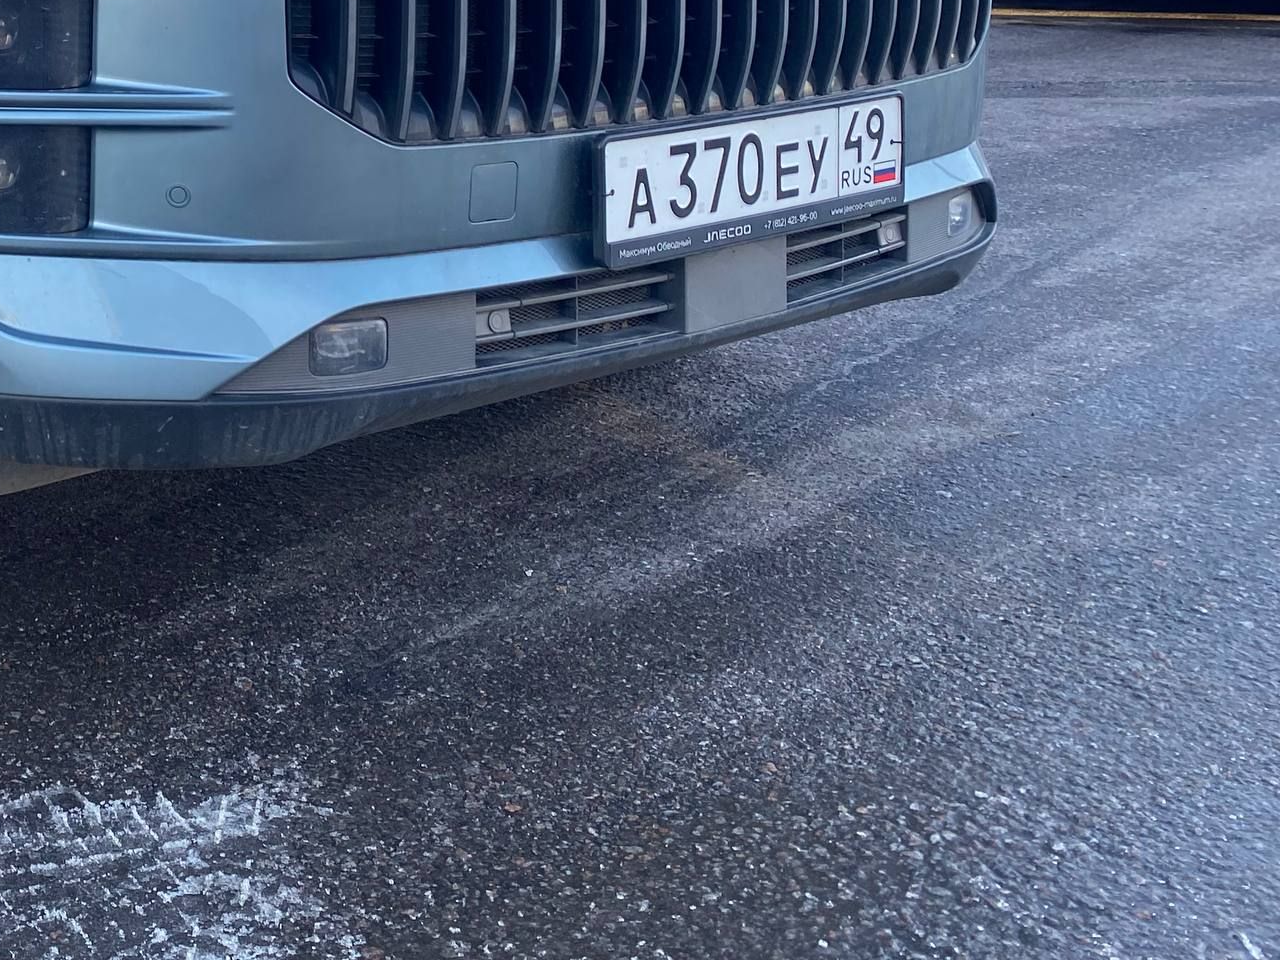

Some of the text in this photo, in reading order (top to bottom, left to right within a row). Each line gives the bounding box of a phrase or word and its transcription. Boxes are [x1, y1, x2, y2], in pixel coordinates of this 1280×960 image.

[628, 107, 885, 228] А370ЕУ 49
[841, 166, 872, 189] RUS
[703, 224, 751, 243] JAECOO
